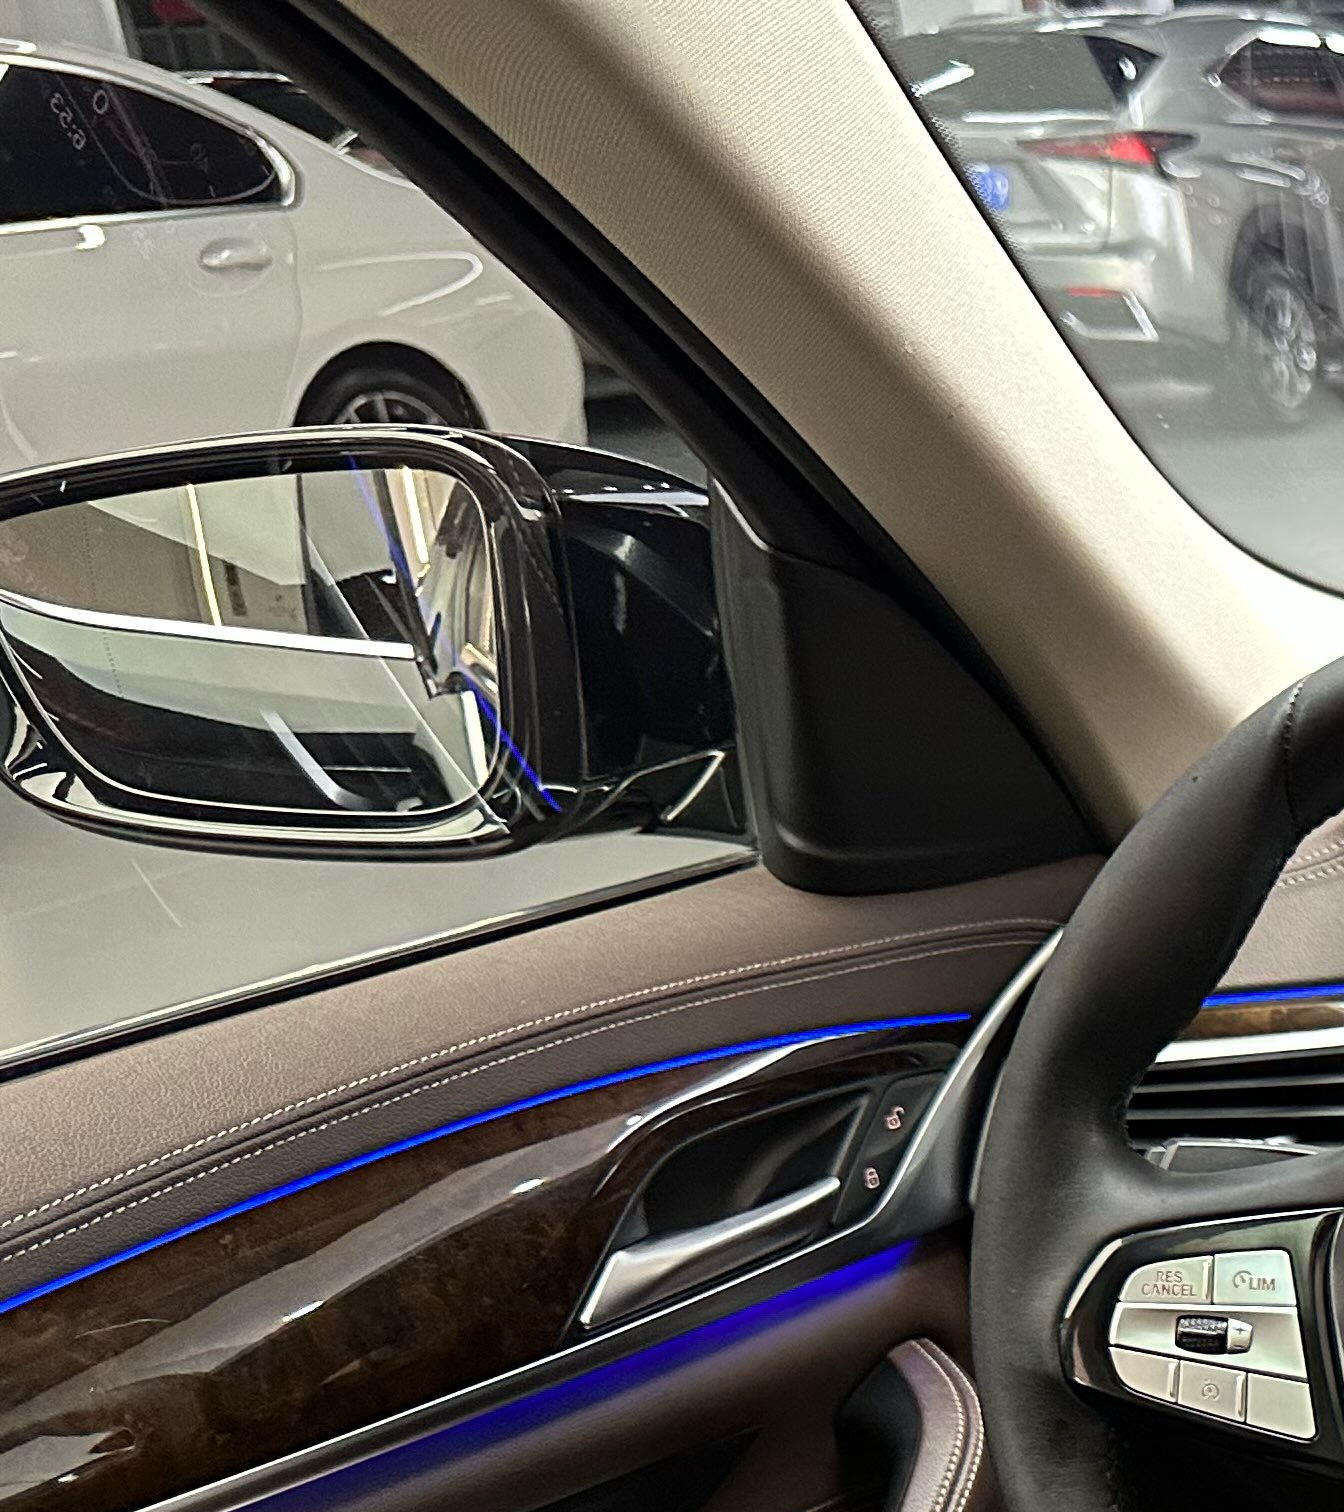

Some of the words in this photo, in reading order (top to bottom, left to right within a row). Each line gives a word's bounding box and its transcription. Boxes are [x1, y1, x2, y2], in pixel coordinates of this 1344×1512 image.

[1156, 1270, 1183, 1283] RES
[1141, 1283, 1198, 1297] CANCEL
[1249, 1277, 1276, 1292] LIM
